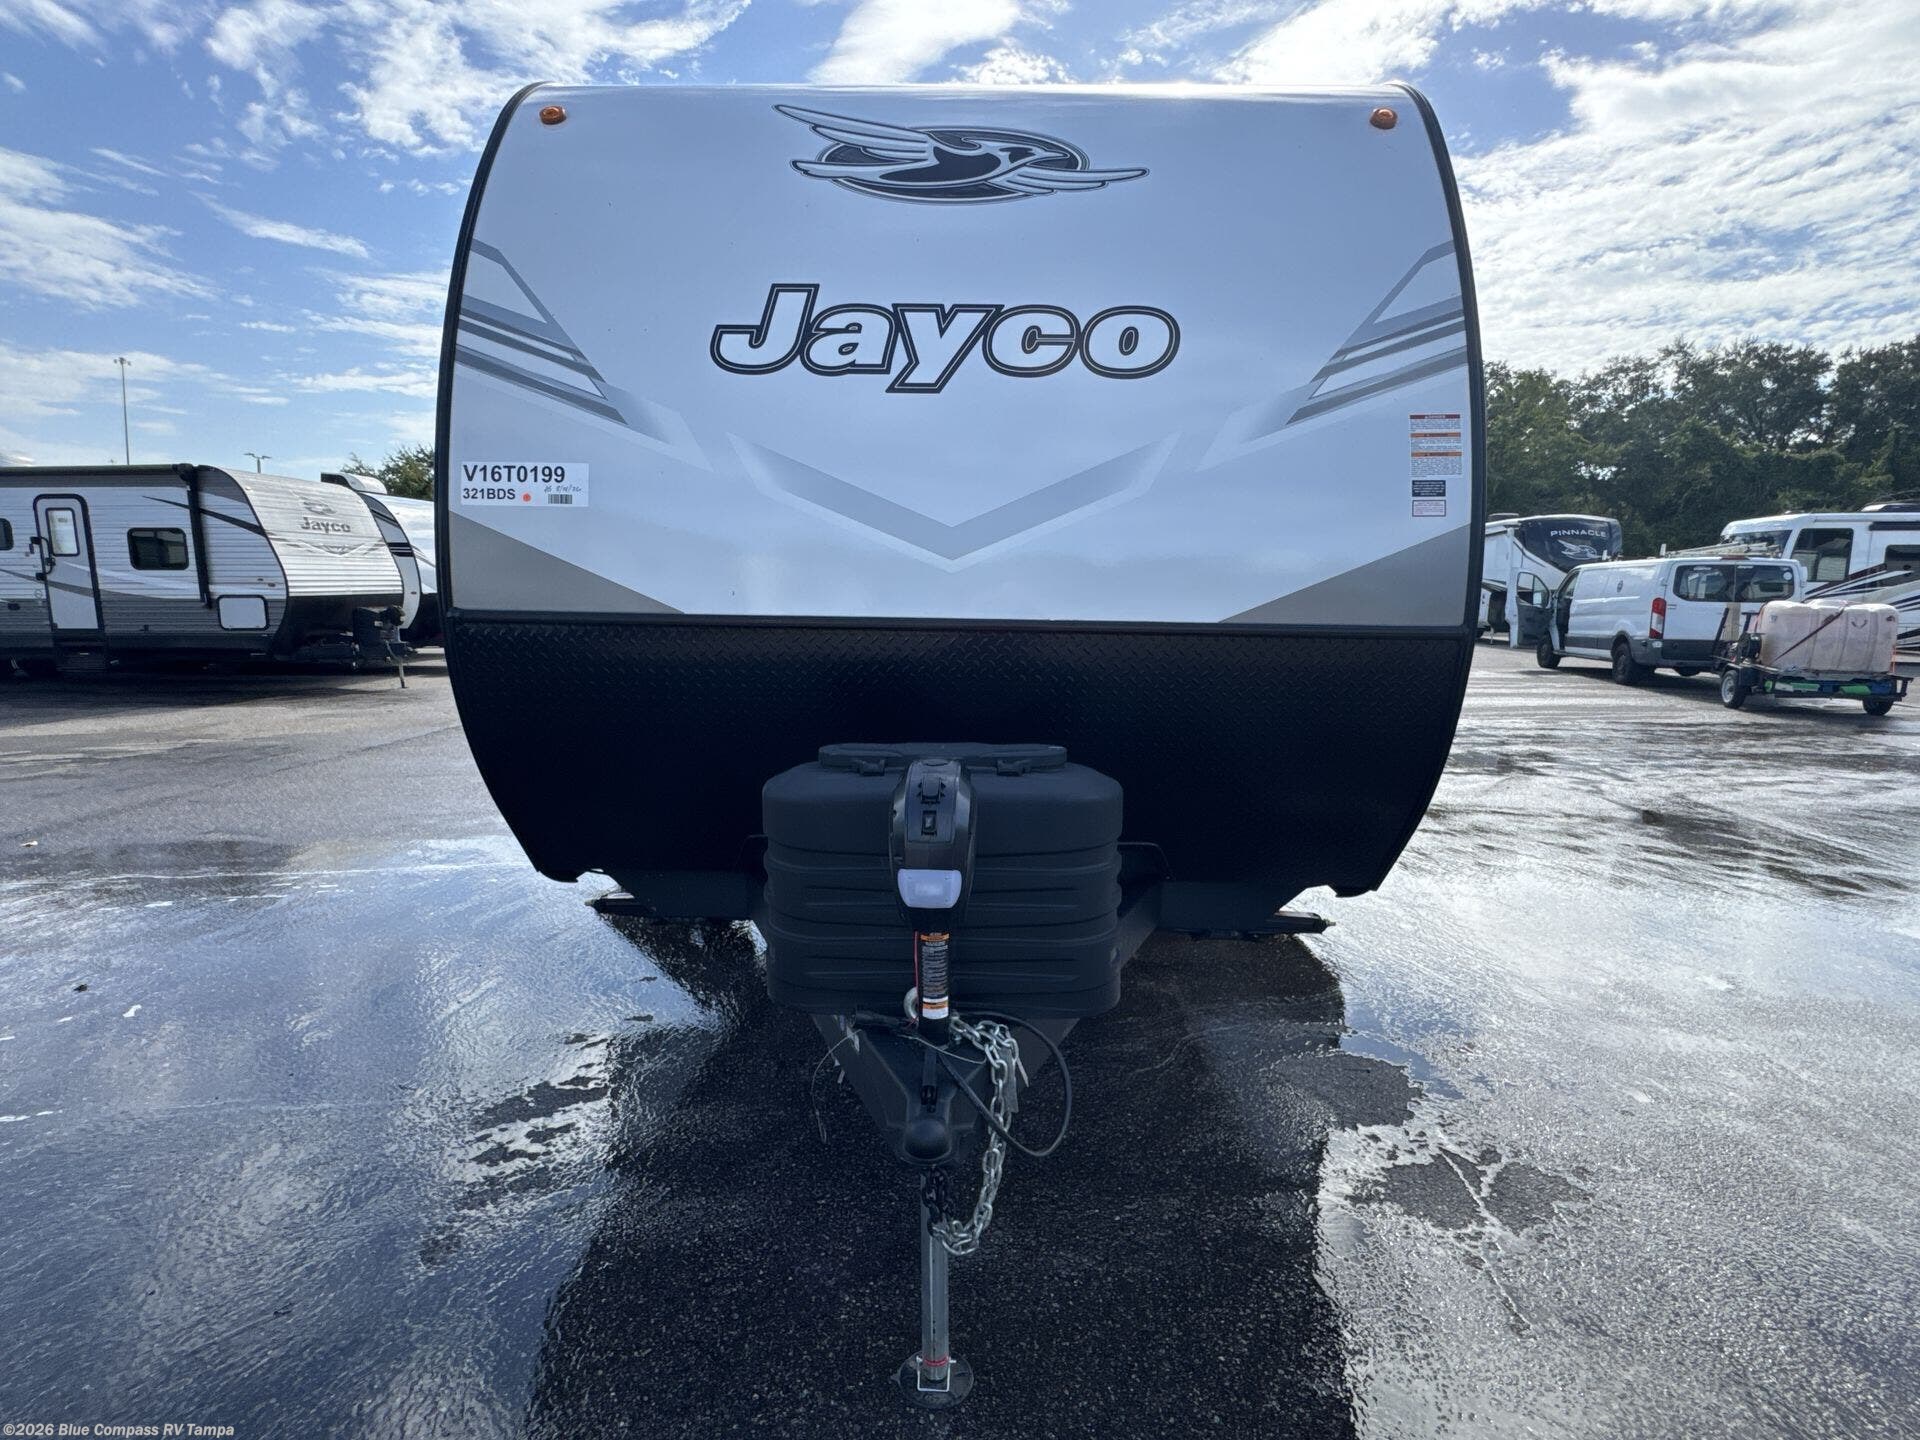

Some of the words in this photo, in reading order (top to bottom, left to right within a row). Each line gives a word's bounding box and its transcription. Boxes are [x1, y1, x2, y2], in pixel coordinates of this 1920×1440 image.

[710, 283, 1181, 394] Jayco
[463, 464, 566, 483] V16T0199
[463, 488, 516, 500] 321BDS
[300, 516, 352, 534] Jayco
[1550, 529, 1607, 538] PINNACLE
